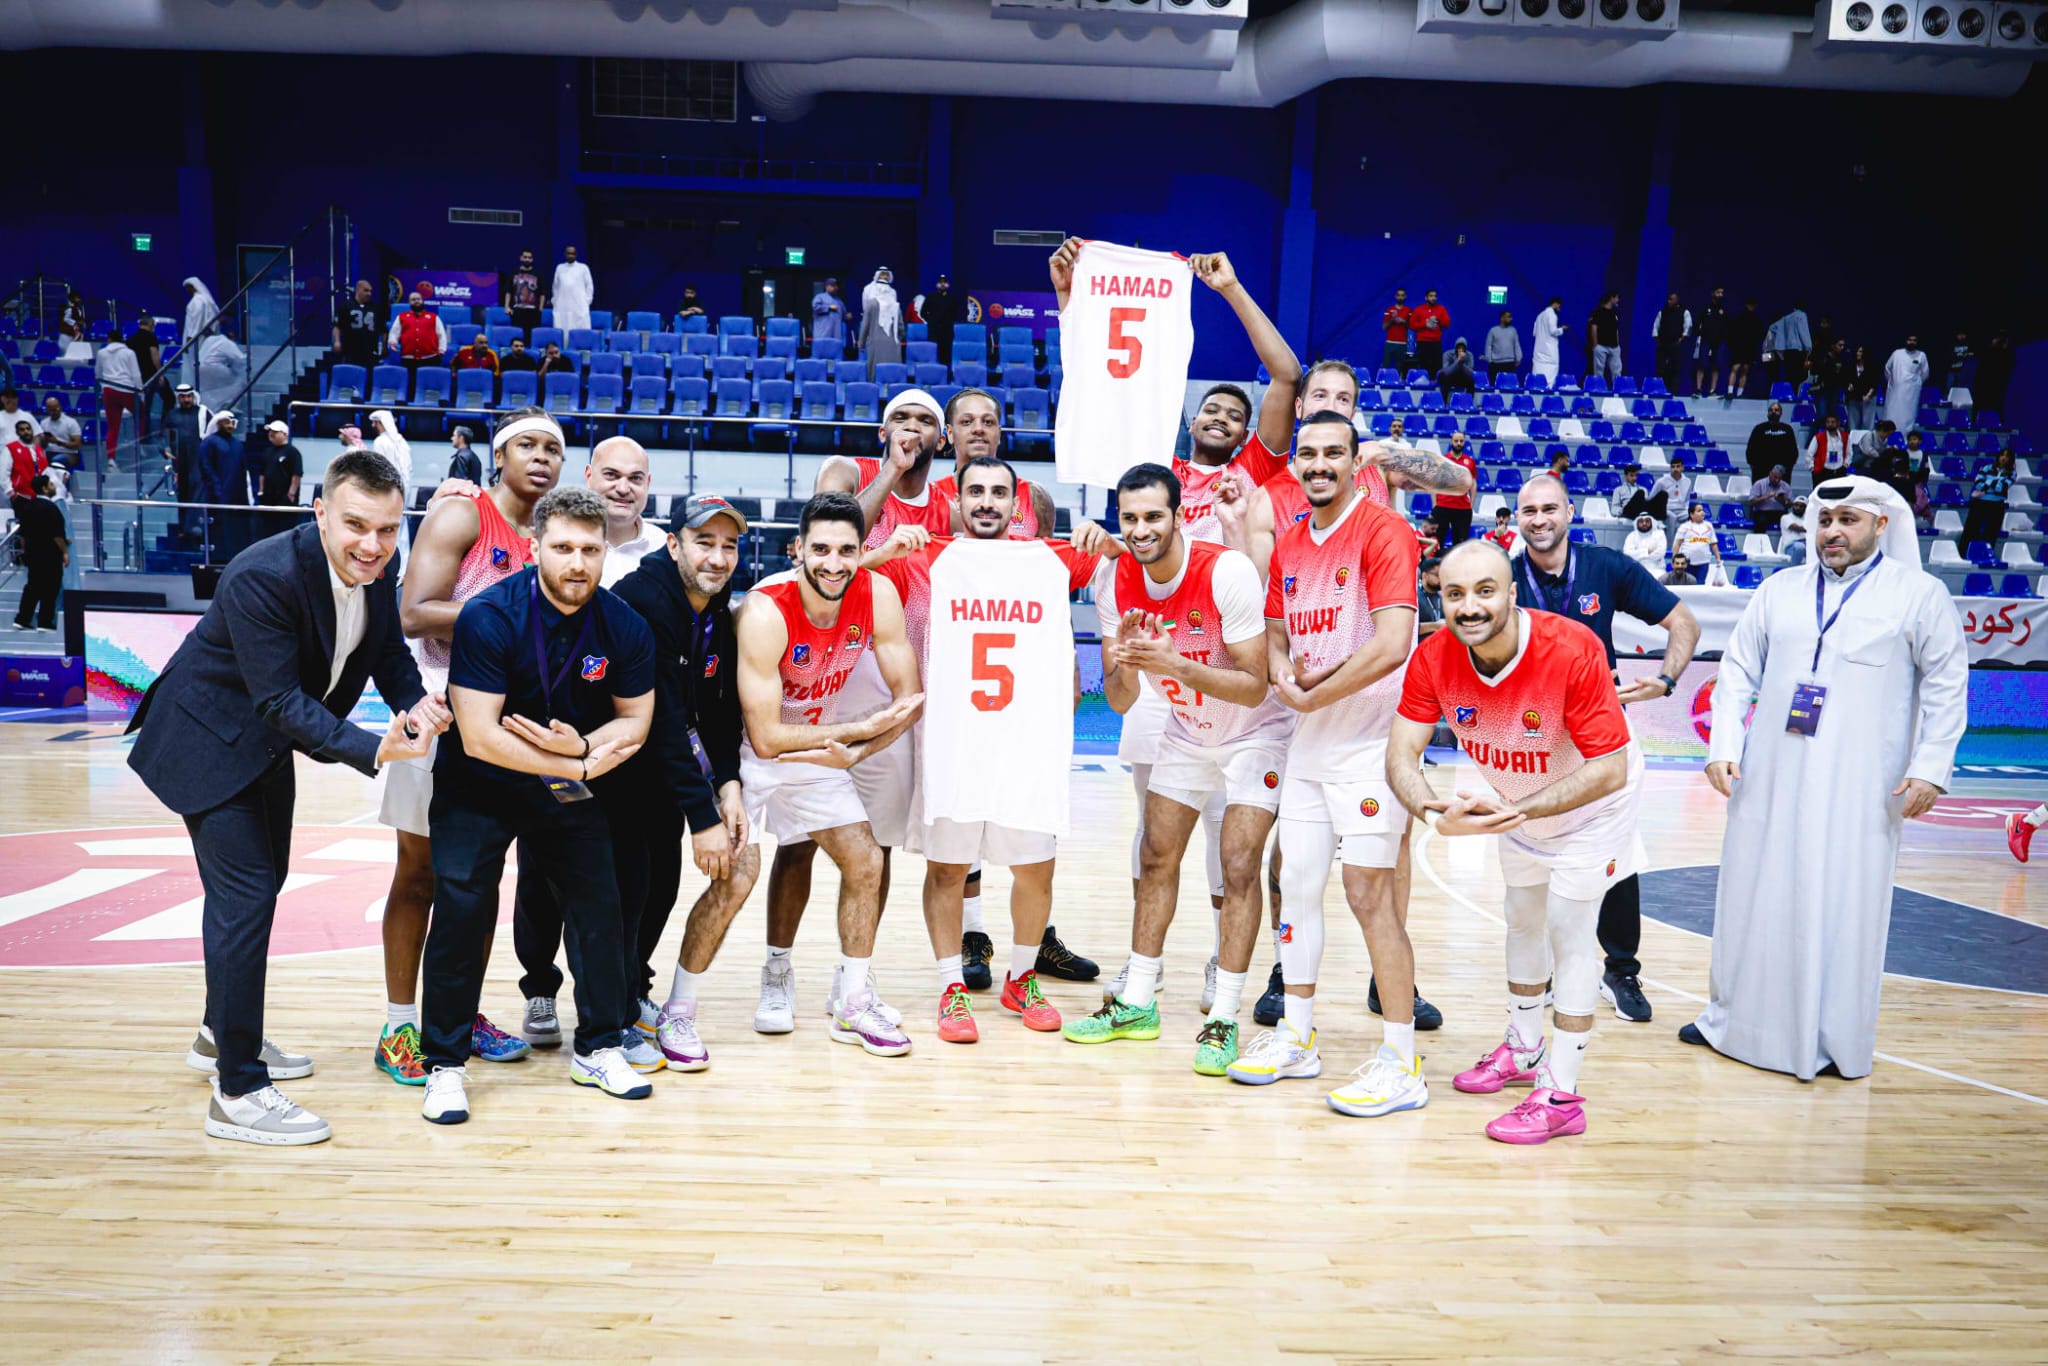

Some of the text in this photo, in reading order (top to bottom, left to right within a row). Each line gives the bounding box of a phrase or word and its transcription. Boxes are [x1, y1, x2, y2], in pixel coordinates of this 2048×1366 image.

[434, 285, 472, 297] WASL
[1090, 275, 1173, 299] HAMAD
[350, 309, 375, 331] 34
[1004, 308, 1034, 318] WASL
[1044, 309, 1060, 317] MED
[1107, 307, 1147, 379] 5
[950, 598, 1043, 624] HAMAD
[970, 632, 1016, 711] 5
[1461, 738, 1551, 774] KUWAIT
